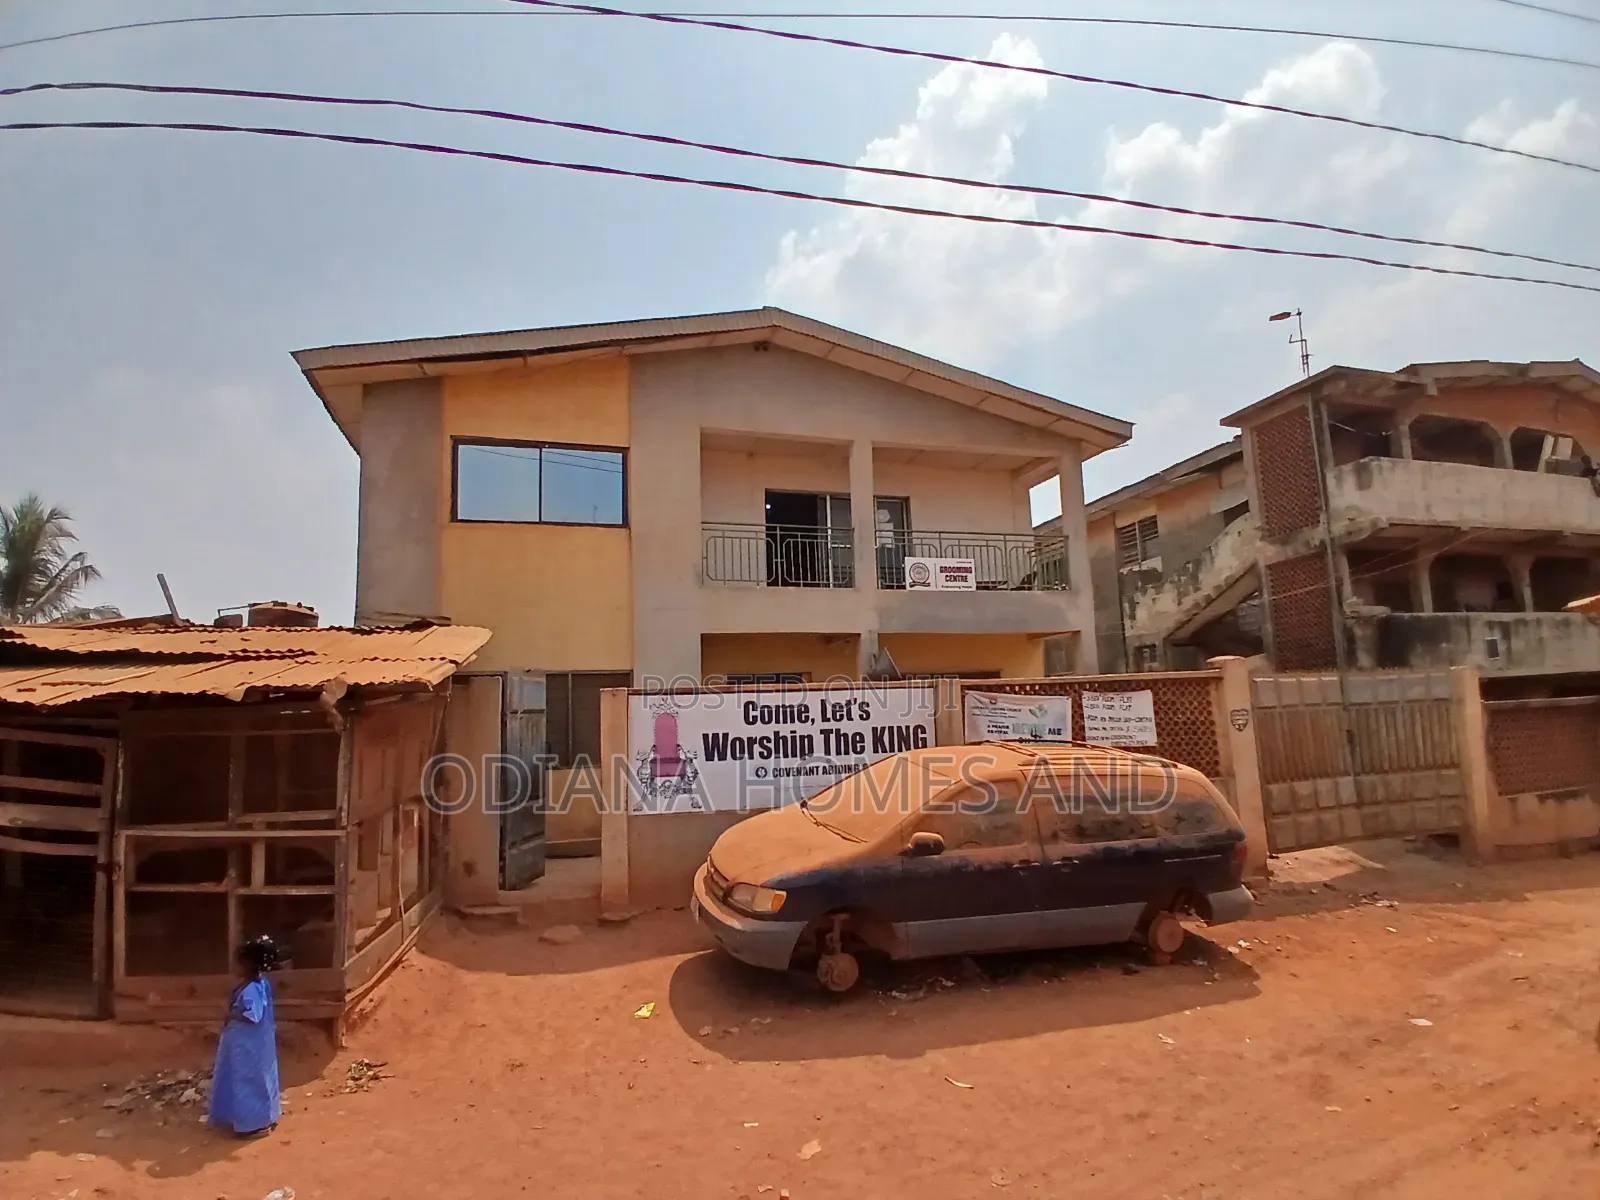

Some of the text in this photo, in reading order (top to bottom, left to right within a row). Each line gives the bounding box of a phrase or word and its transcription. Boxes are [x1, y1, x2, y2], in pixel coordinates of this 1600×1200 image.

[743, 697, 871, 725] Come, Let's
[1048, 727, 1062, 736] ME
[702, 723, 928, 762] Worship The KING
[772, 766, 820, 778] COVENANT
[822, 764, 861, 775] ABIDING
